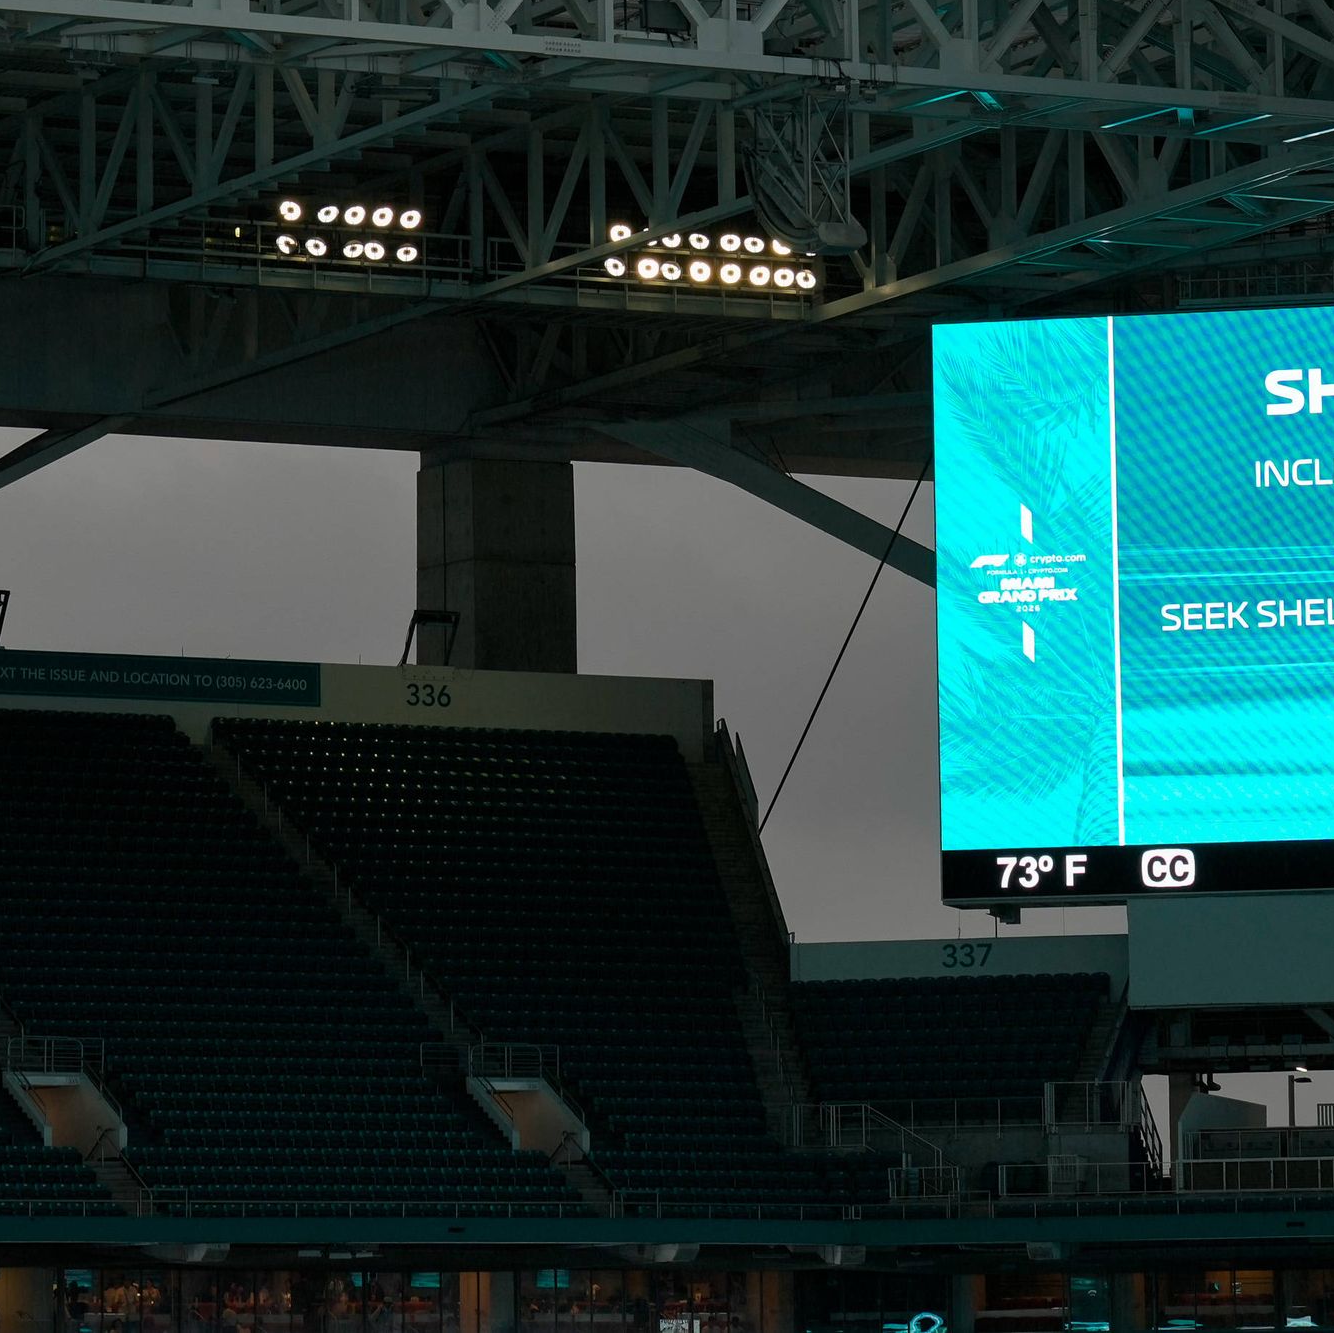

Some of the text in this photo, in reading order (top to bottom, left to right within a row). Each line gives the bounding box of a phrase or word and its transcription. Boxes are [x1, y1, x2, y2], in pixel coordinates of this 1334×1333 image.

[1030, 553, 1086, 565] crypto.com
[1000, 577, 1055, 590] MIAMI
[978, 588, 1078, 604] GRAND PRIX
[1161, 601, 1249, 631] SEEK
[20, 667, 46, 680] THE
[49, 668, 86, 682] ISSUE
[89, 669, 120, 683] AND
[123, 671, 191, 687] LOCATION
[194, 674, 213, 687] TO
[215, 675, 247, 690] (305)
[250, 676, 308, 691] 623-6400
[406, 684, 451, 707] 336
[1065, 854, 1088, 887] F
[1147, 855, 1190, 882] CC
[942, 943, 993, 968] 337
